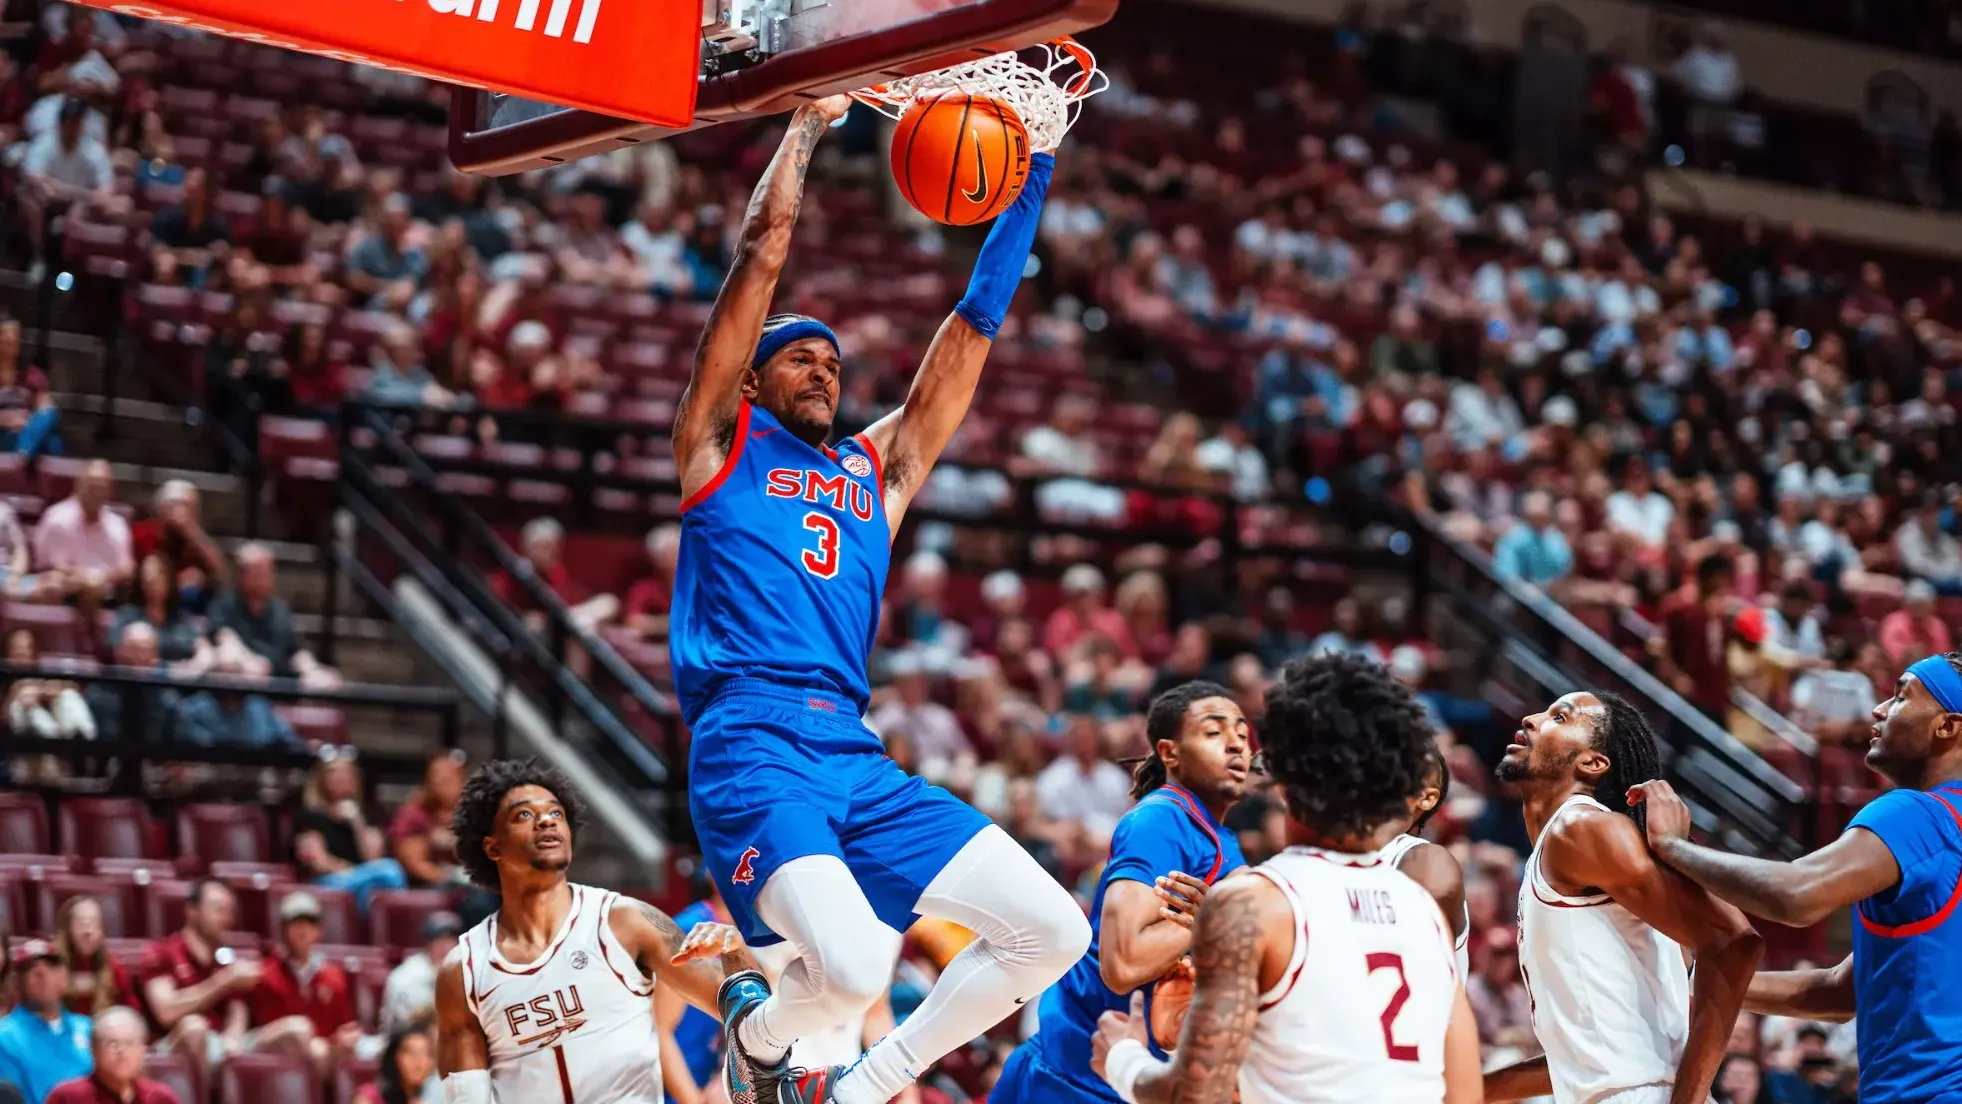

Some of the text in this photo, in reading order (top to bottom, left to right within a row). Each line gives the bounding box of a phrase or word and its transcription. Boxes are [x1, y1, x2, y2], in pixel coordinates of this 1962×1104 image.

[766, 468, 873, 521] SMU
[801, 511, 840, 580] 3
[808, 697, 836, 713] SMU
[1346, 888, 1396, 924] MILES
[504, 985, 584, 1036] FSU
[1365, 952, 1420, 1061] 2
[552, 1045, 575, 1104] 1
